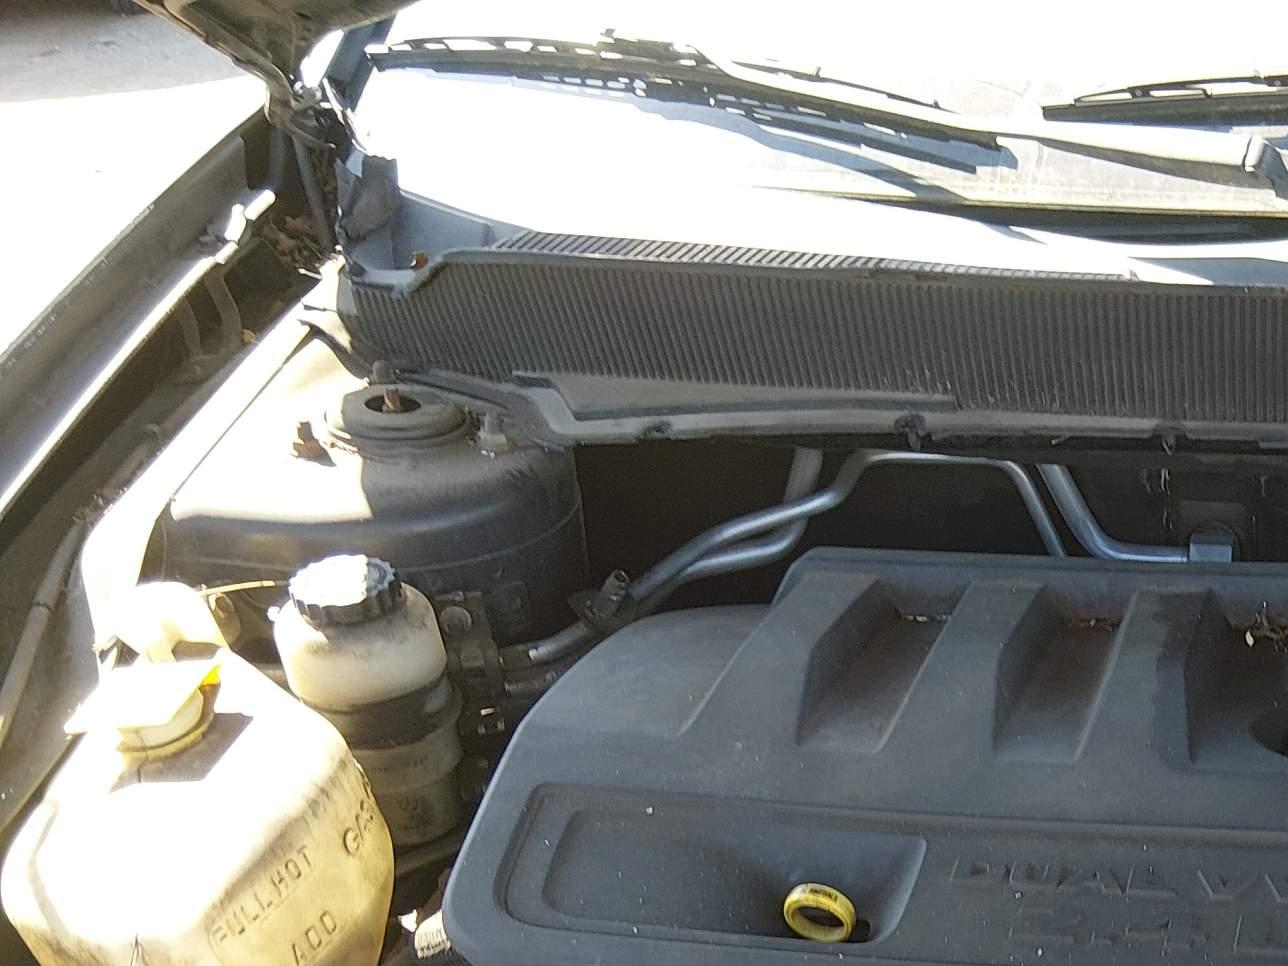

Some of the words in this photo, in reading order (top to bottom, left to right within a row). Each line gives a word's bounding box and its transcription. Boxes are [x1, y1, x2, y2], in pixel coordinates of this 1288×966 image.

[210, 892, 272, 942] FULL
[271, 844, 313, 896] HOT
[949, 855, 1178, 898] DUAL
